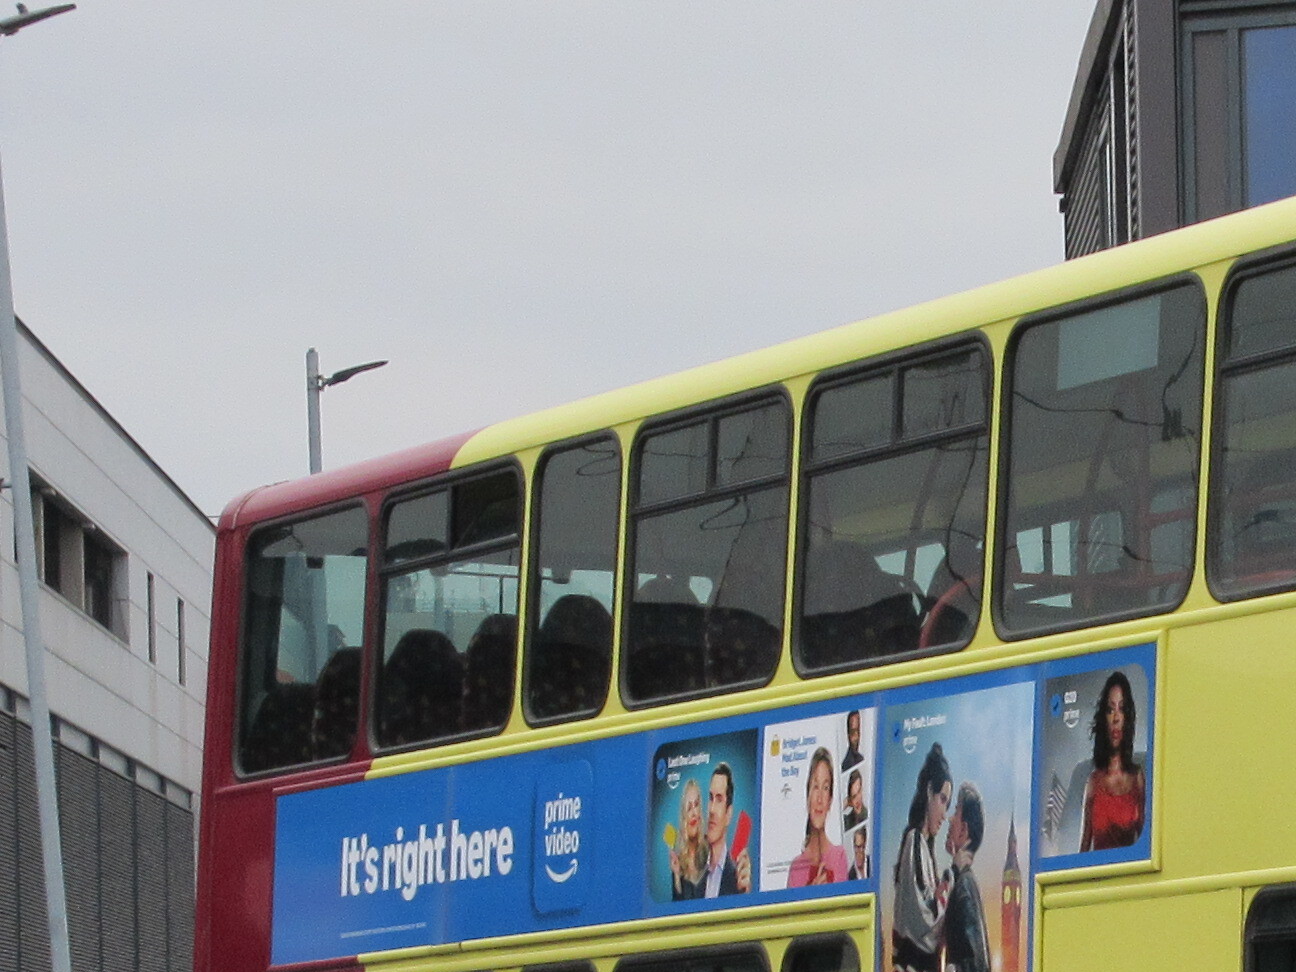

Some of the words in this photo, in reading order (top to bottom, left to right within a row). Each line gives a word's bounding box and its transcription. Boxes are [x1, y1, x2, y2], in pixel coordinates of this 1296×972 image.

[544, 792, 582, 829] prime
[340, 832, 381, 897] It's
[381, 822, 446, 901] right
[449, 818, 514, 881] here
[544, 827, 580, 857] video
